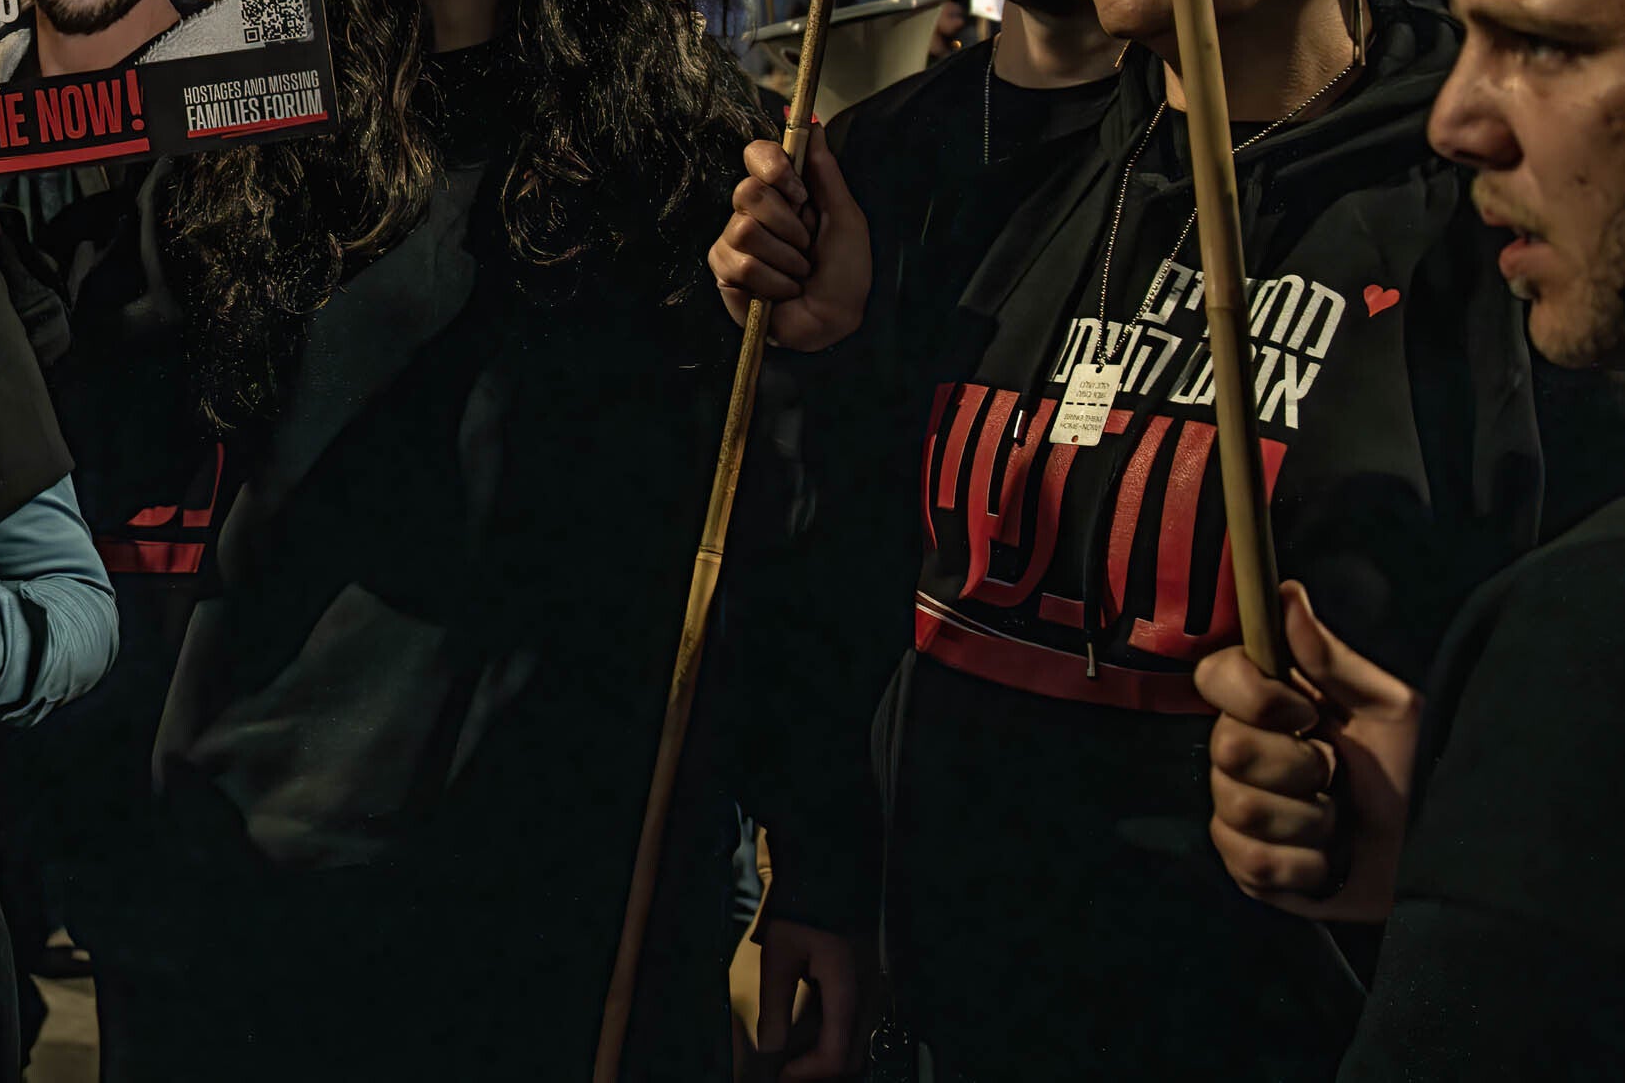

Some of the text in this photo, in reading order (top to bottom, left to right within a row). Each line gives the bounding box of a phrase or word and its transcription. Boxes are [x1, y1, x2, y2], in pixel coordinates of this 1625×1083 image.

[184, 69, 319, 105] HOSTAGES AND MISSING
[187, 89, 324, 131] FAMILIES FORUM
